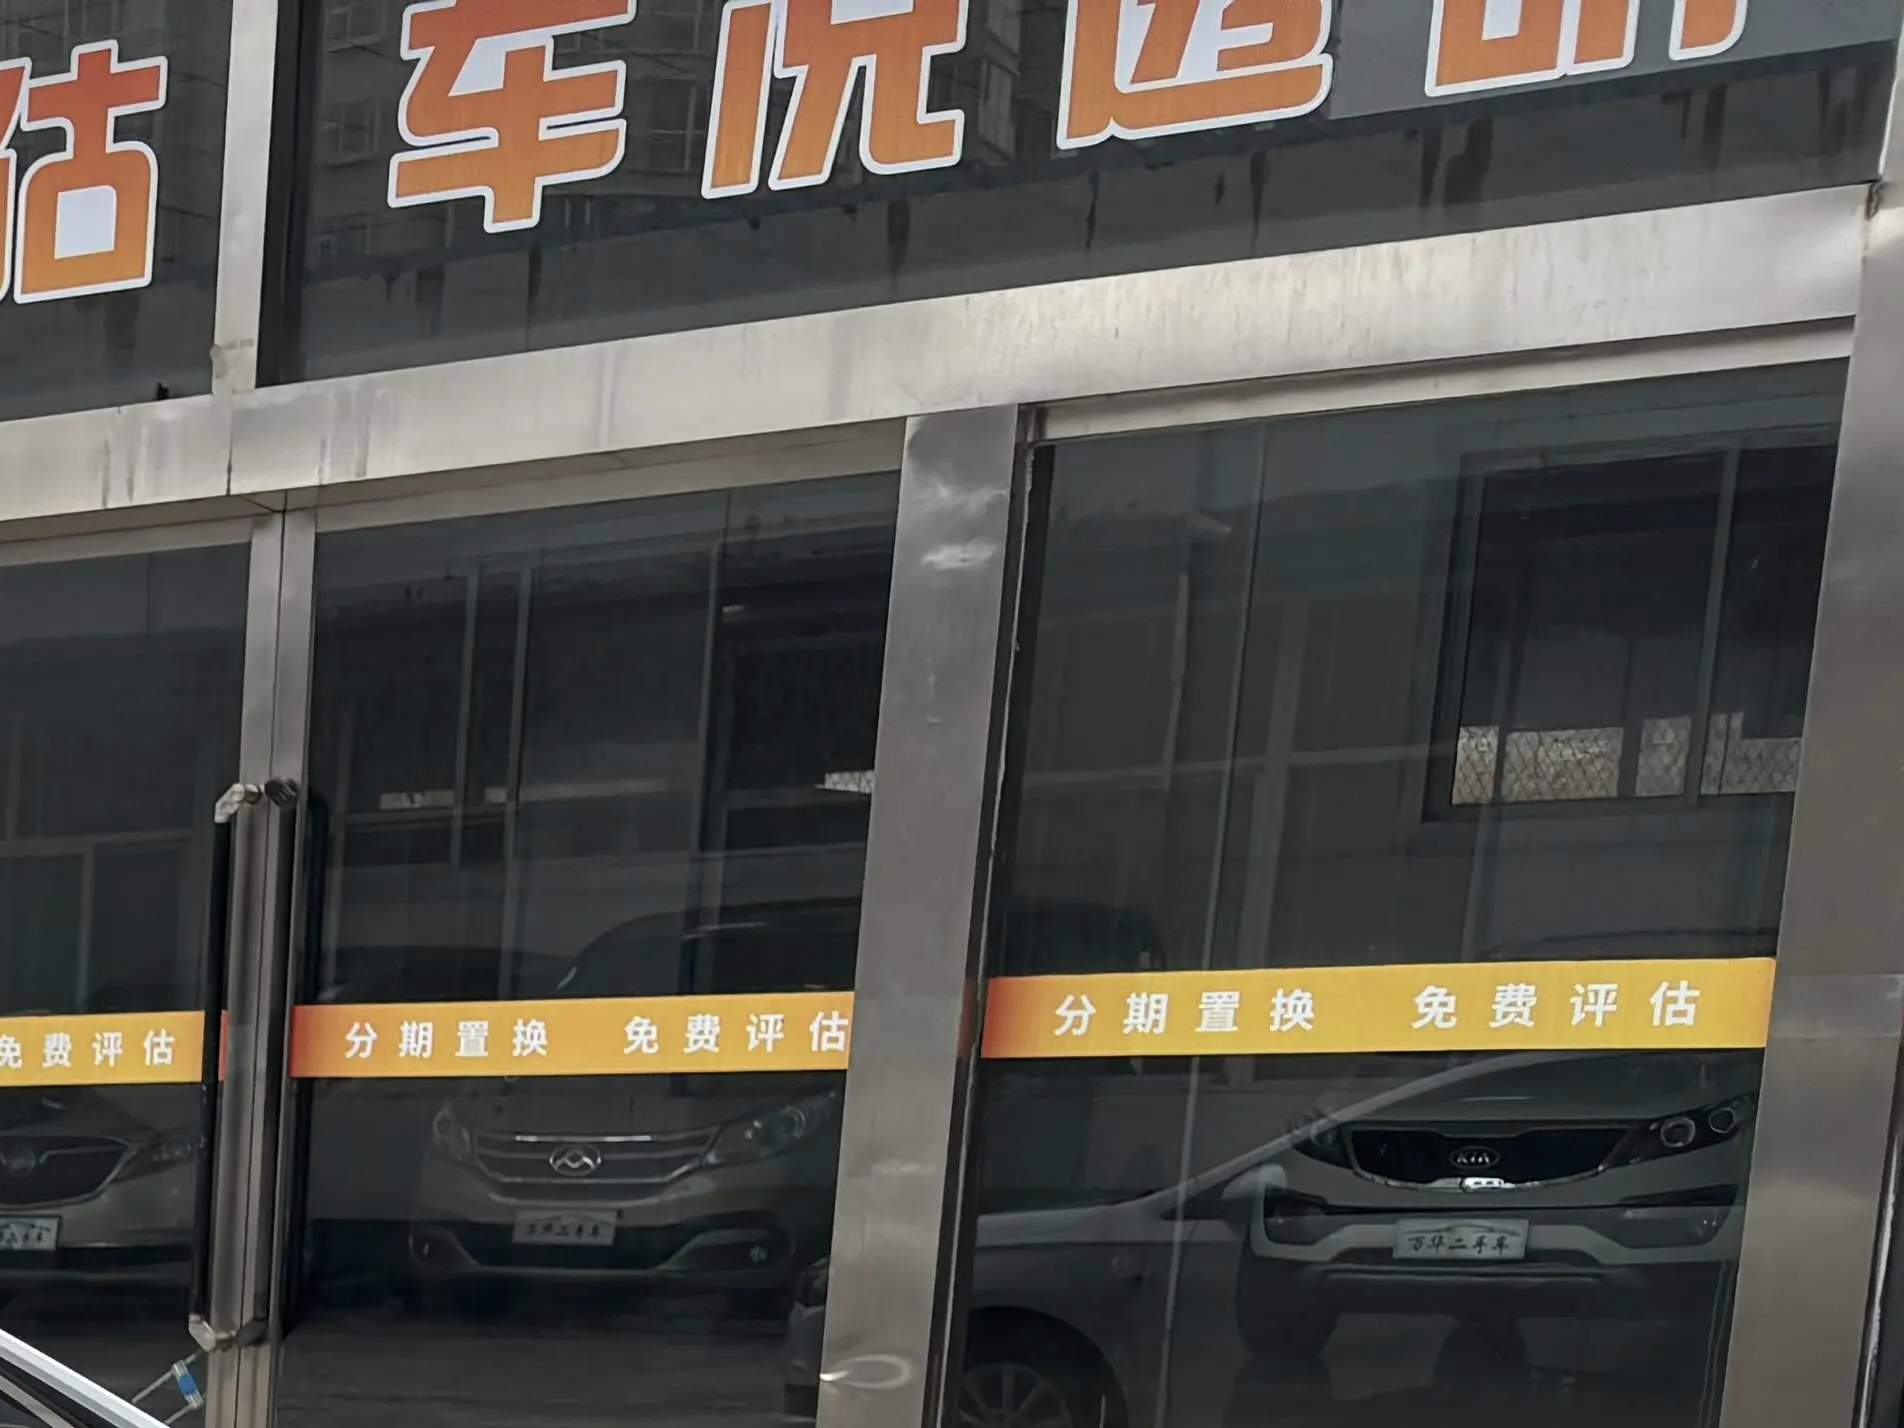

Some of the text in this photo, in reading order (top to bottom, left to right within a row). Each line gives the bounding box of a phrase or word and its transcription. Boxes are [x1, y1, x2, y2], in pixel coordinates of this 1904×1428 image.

[388, 0, 1748, 234] 车况
[1054, 980, 1701, 1037] 分期置换 免费评估
[345, 1011, 849, 1058] 分期置换 免费评估
[1455, 1152, 1491, 1165] KIA
[1407, 1234, 1511, 1255] 万华二手车
